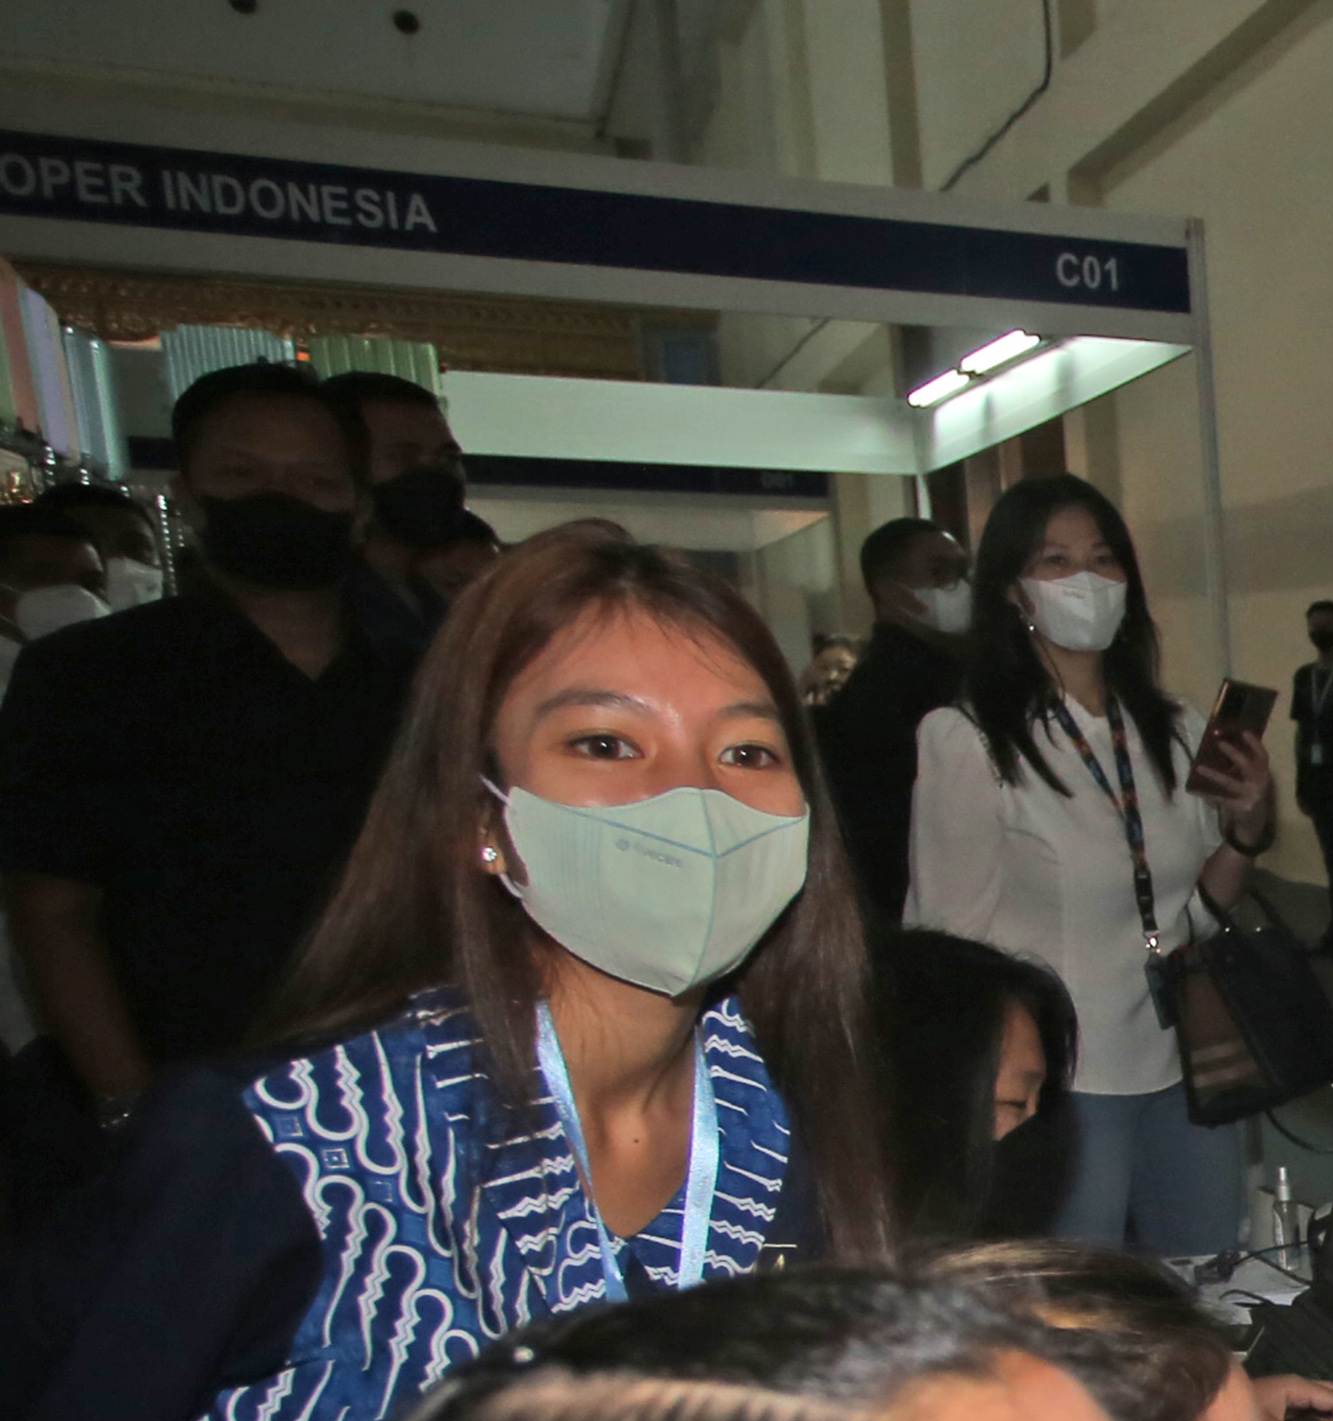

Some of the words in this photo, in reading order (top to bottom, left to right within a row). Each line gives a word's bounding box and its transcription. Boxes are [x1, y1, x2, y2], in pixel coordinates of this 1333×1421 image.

[1, 153, 148, 208] OPER
[161, 169, 439, 234] INDONESIA
[1056, 253, 1119, 291] C01
